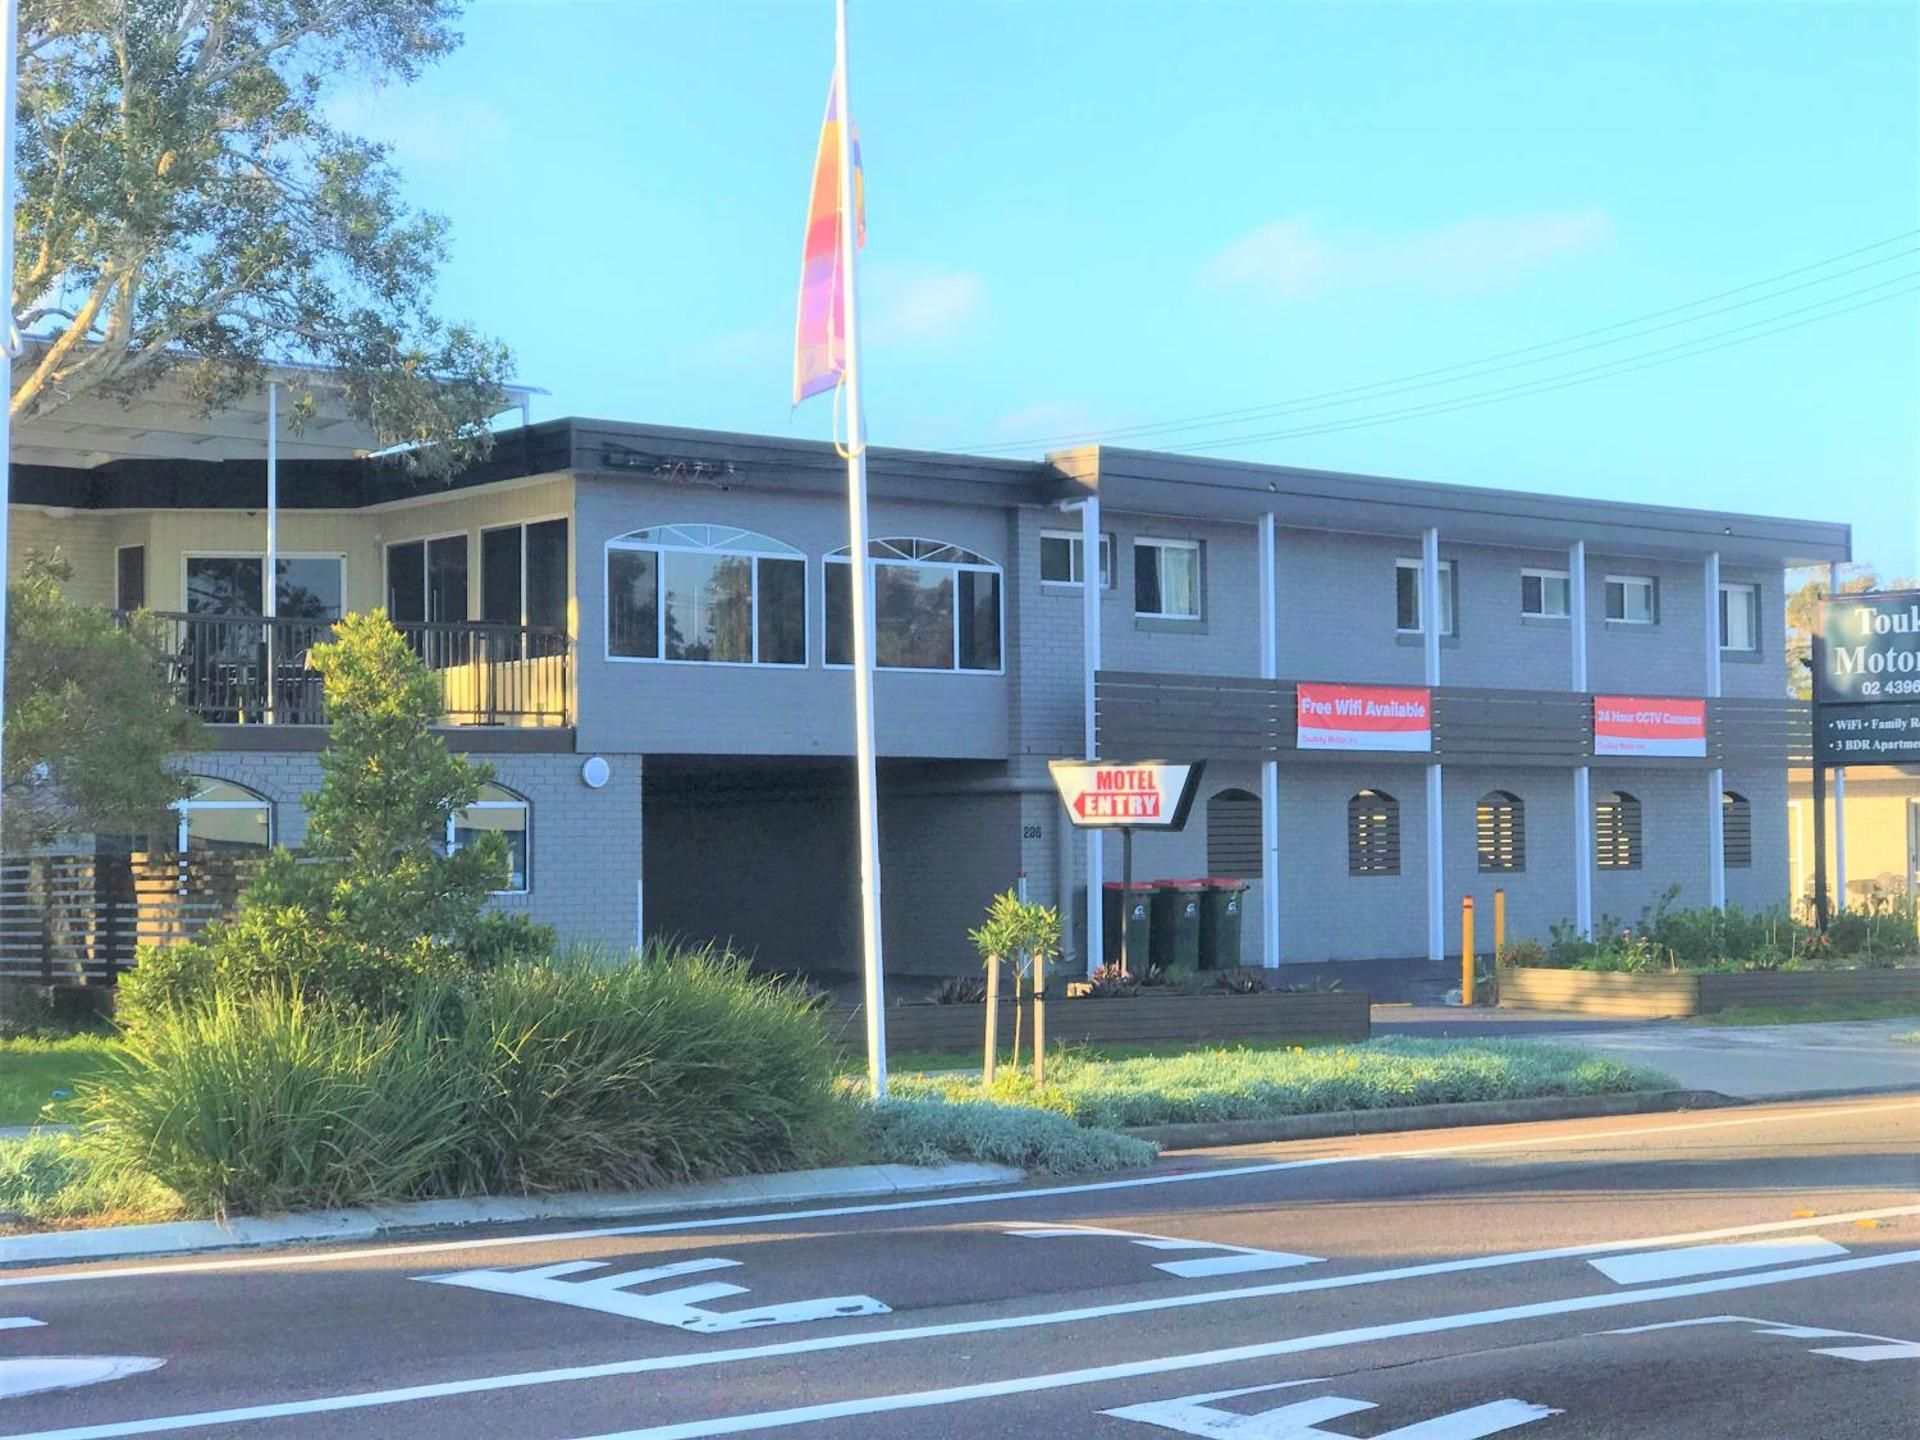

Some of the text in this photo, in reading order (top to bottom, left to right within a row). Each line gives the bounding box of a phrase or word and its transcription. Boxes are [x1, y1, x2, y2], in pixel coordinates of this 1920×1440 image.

[1862, 679, 1920, 695] 02 4396
[1302, 698, 1425, 718] Free Wifi Available
[1635, 711, 1662, 724] CCTV
[1872, 718, 1907, 731] Family
[1910, 717, 1920, 728] R
[1835, 739, 1920, 752] 3 BDR Apartme
[1097, 770, 1156, 790] MOTEL
[1085, 795, 1156, 815] ENTRY
